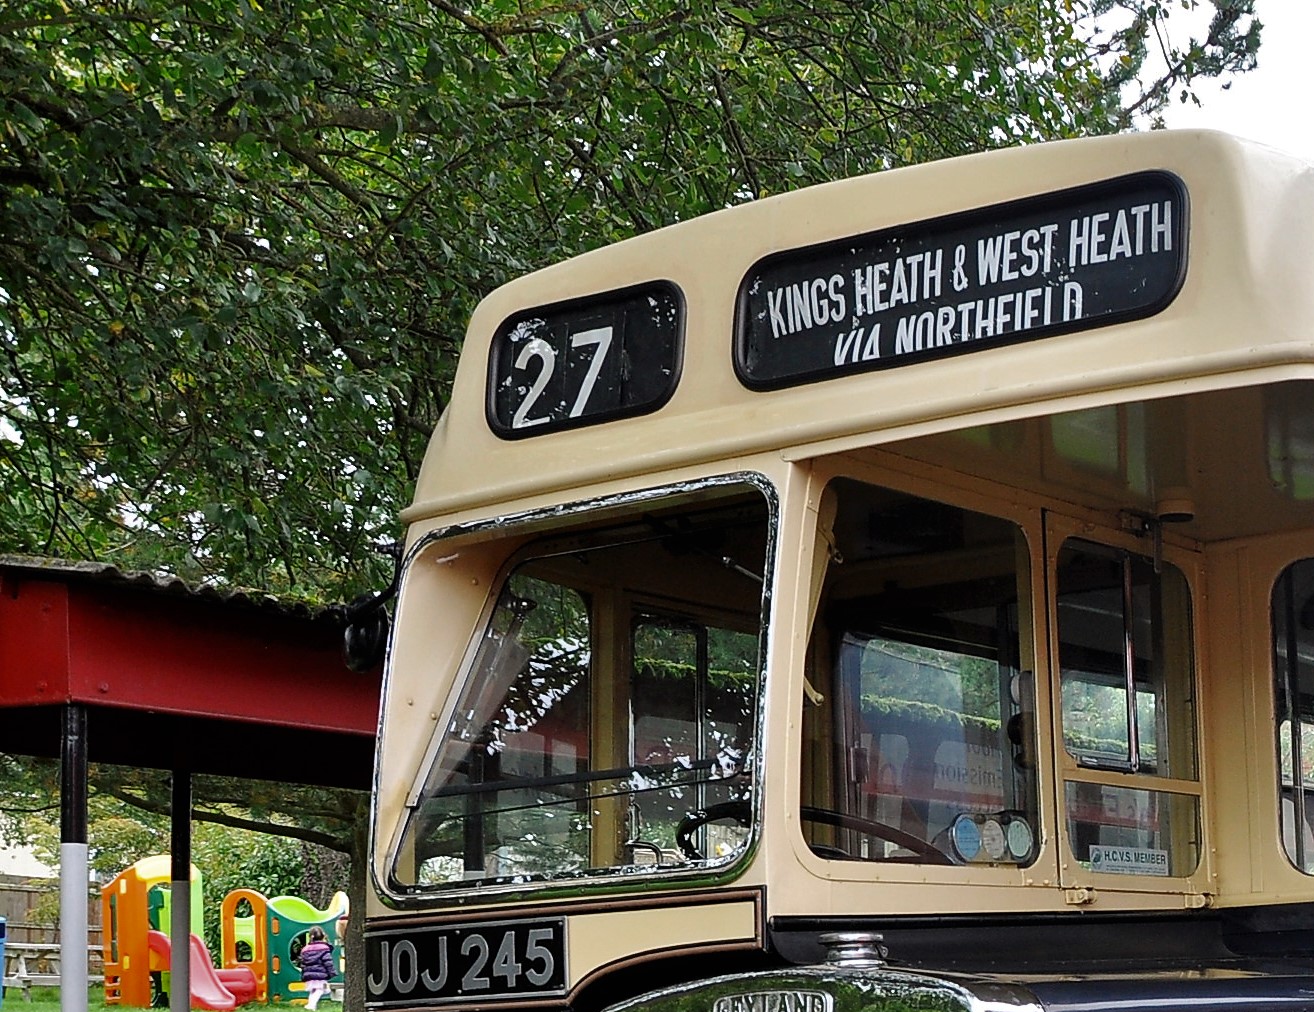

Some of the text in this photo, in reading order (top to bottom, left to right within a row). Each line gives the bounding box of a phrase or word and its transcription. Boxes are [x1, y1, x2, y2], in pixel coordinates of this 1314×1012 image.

[766, 200, 1173, 339] KINGS HEATH & WEST HEATH
[511, 325, 614, 430] 27
[833, 322, 881, 367] VIA
[1133, 853, 1166, 866] MEMBER
[367, 927, 555, 995] JOJ 245
